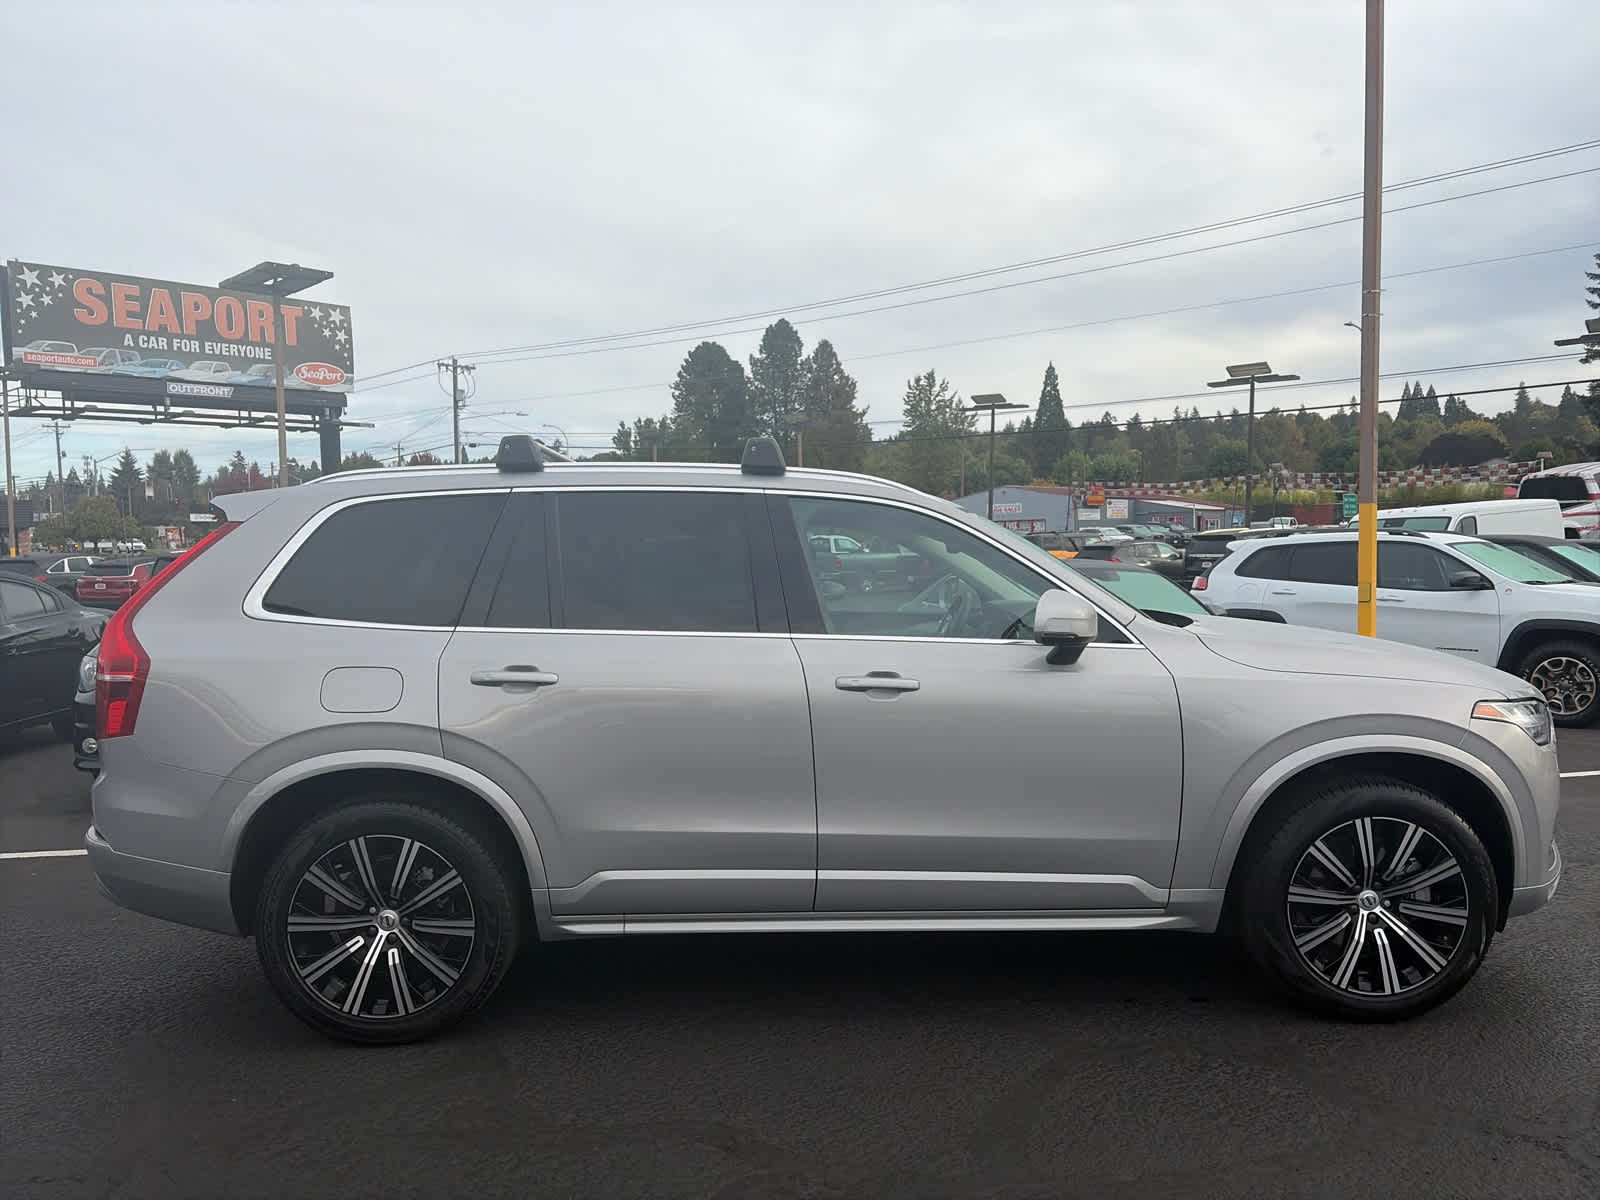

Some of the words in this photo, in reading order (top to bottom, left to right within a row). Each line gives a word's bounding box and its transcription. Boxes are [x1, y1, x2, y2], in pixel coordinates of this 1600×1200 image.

[73, 277, 303, 346] SEAPORT
[123, 333, 134, 347] A
[139, 335, 167, 350] CAR
[173, 338, 199, 353] FOR
[204, 341, 272, 360] EVERYONE
[26, 353, 94, 366] seaportauto.com
[298, 366, 342, 380] SeaPort
